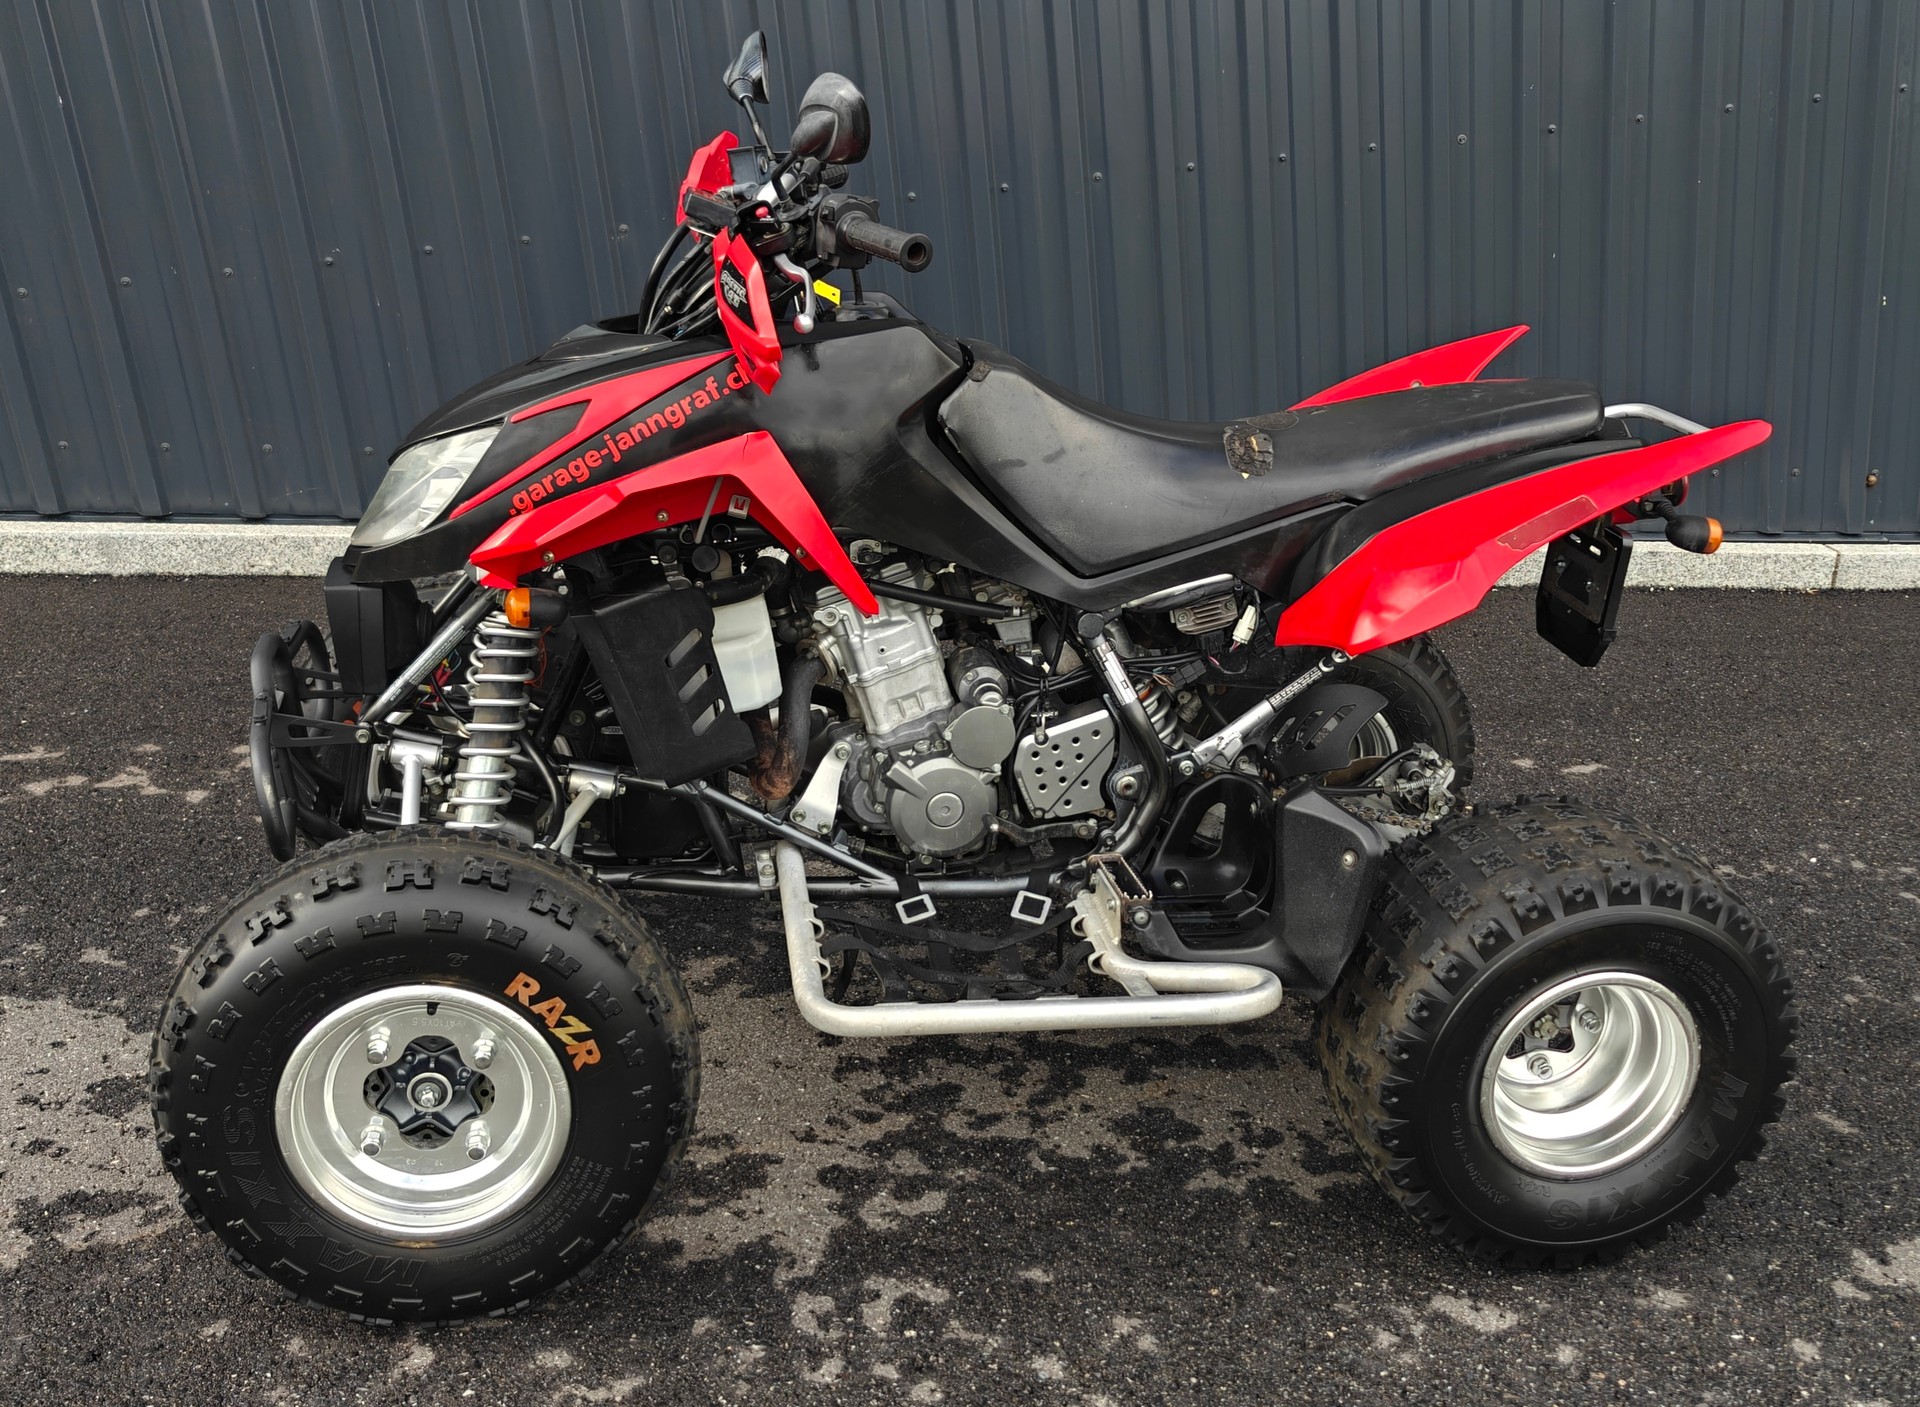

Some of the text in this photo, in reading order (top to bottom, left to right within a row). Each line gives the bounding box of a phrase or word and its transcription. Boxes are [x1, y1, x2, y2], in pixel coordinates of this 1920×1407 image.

[504, 972, 602, 1072] RAZR
[222, 1104, 427, 1288] MAXXIS
[1545, 1072, 1749, 1230] MAXXIS
